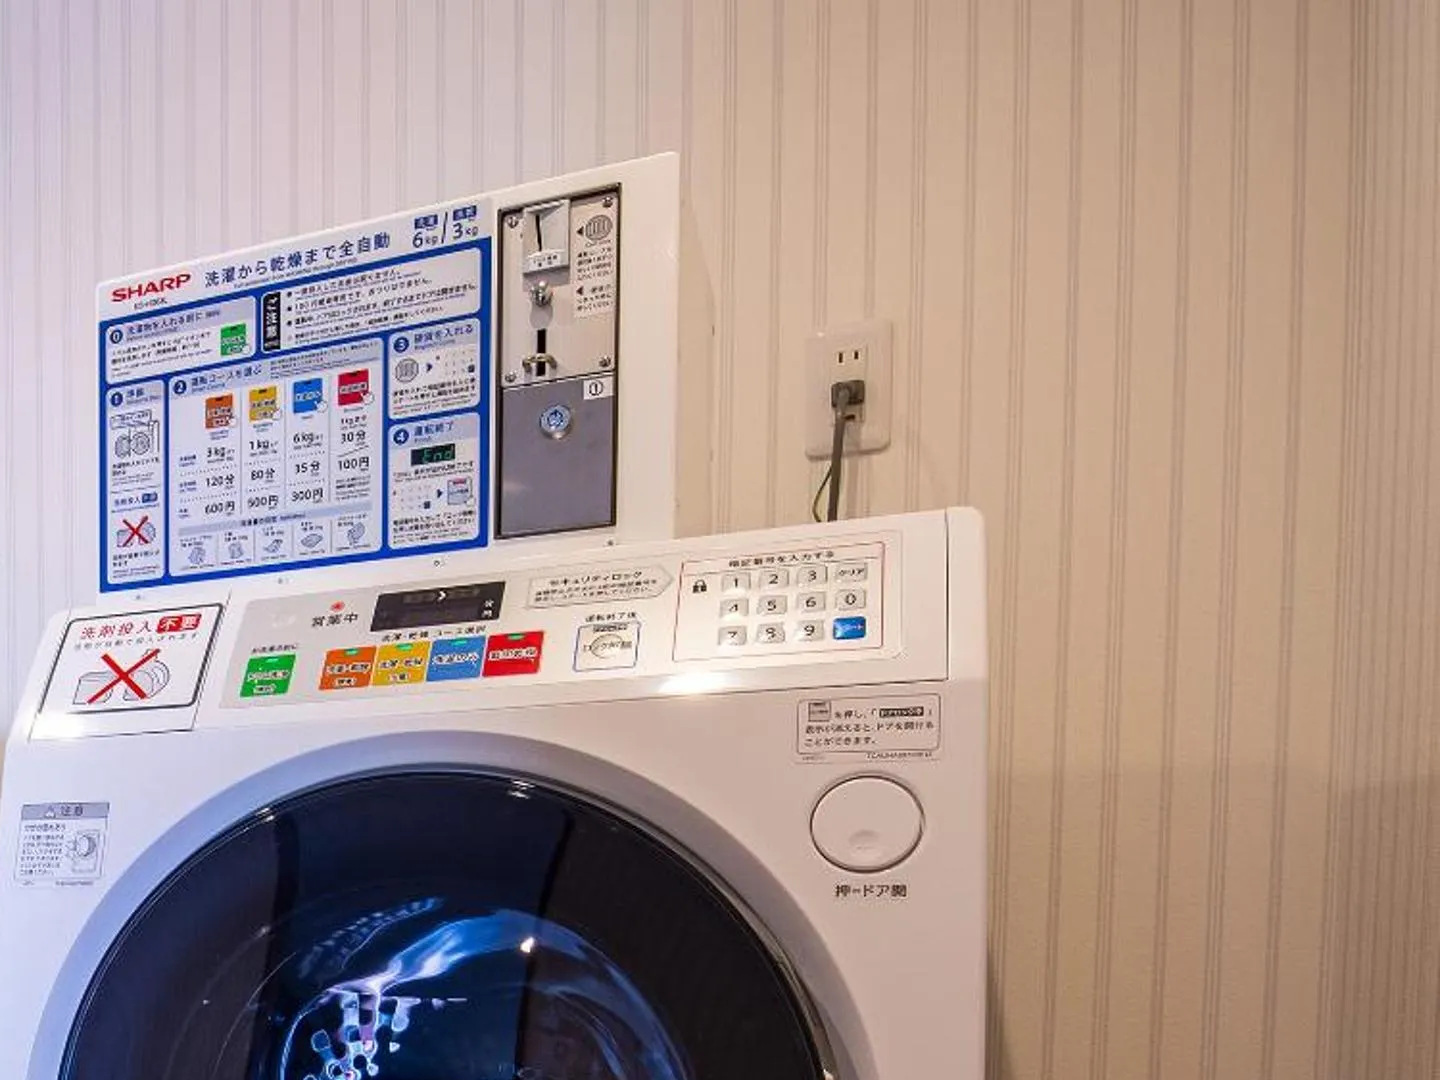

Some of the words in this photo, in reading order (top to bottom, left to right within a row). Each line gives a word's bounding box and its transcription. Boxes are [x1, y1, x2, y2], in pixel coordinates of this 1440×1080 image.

[203, 232, 391, 288] 洗濯から乾燥まで全自動
[111, 273, 192, 303] SHARP
[768, 573, 779, 585] 2
[808, 570, 818, 583] 3
[766, 599, 777, 612] 5
[805, 596, 817, 609] 6
[845, 593, 857, 607] 0
[312, 612, 359, 627] 営業中
[79, 620, 152, 640] 洗剤投入
[765, 626, 776, 639] 8
[804, 624, 816, 636] 9
